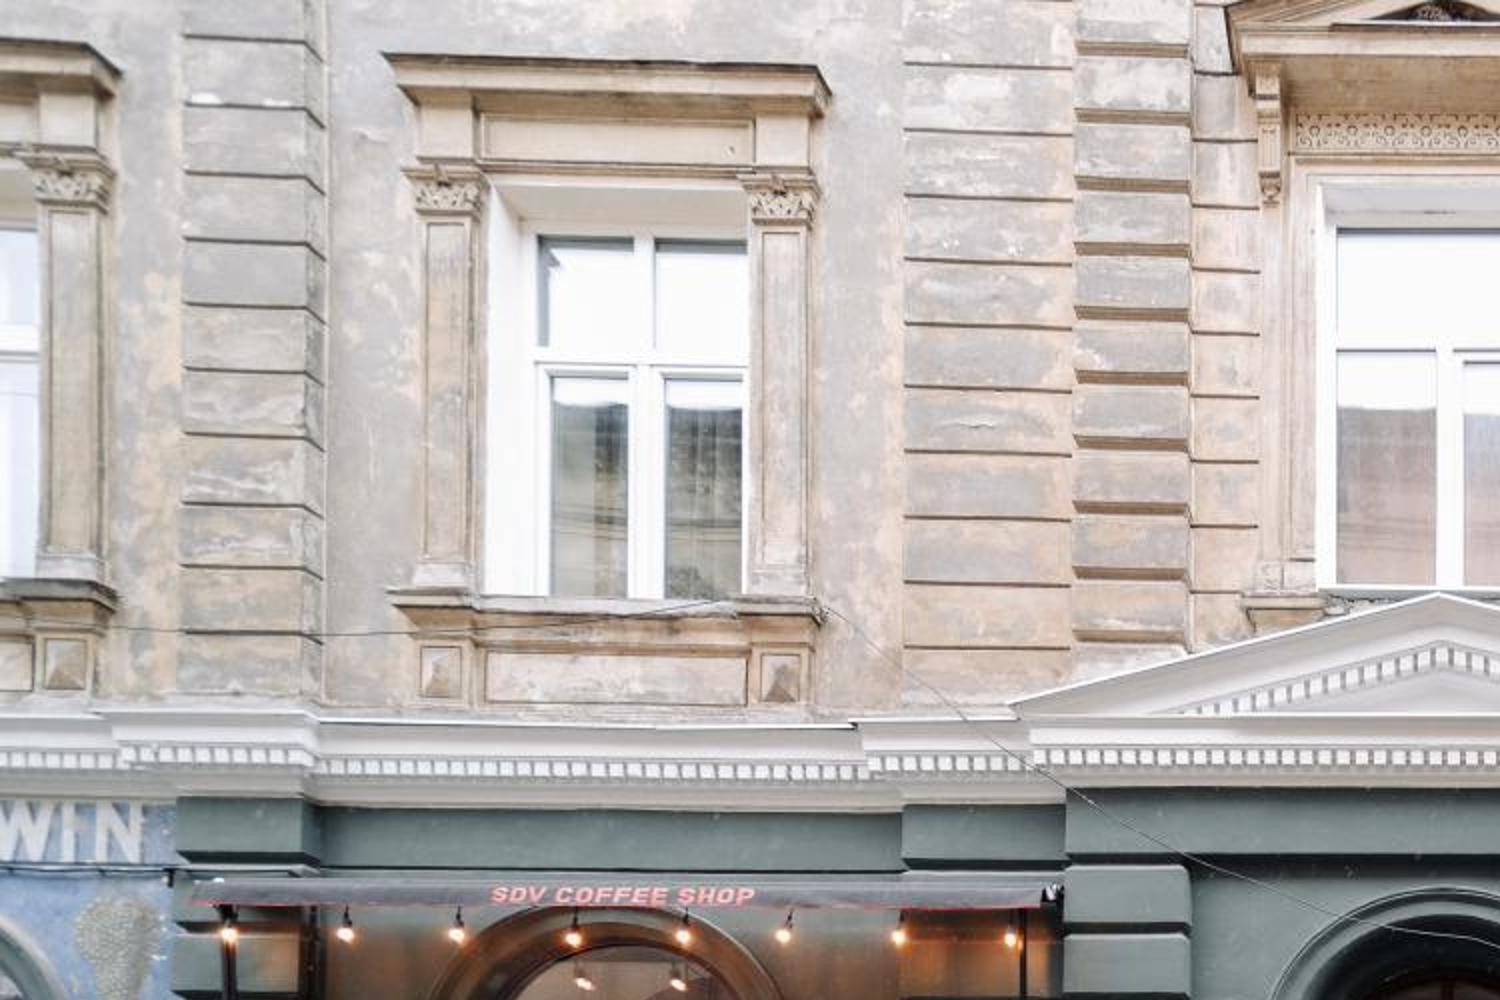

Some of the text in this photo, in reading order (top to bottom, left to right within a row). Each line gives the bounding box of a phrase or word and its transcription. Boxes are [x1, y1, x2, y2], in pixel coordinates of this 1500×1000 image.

[0, 800, 144, 863] WIN
[491, 886, 755, 906] SDV COFFEE SHOP
